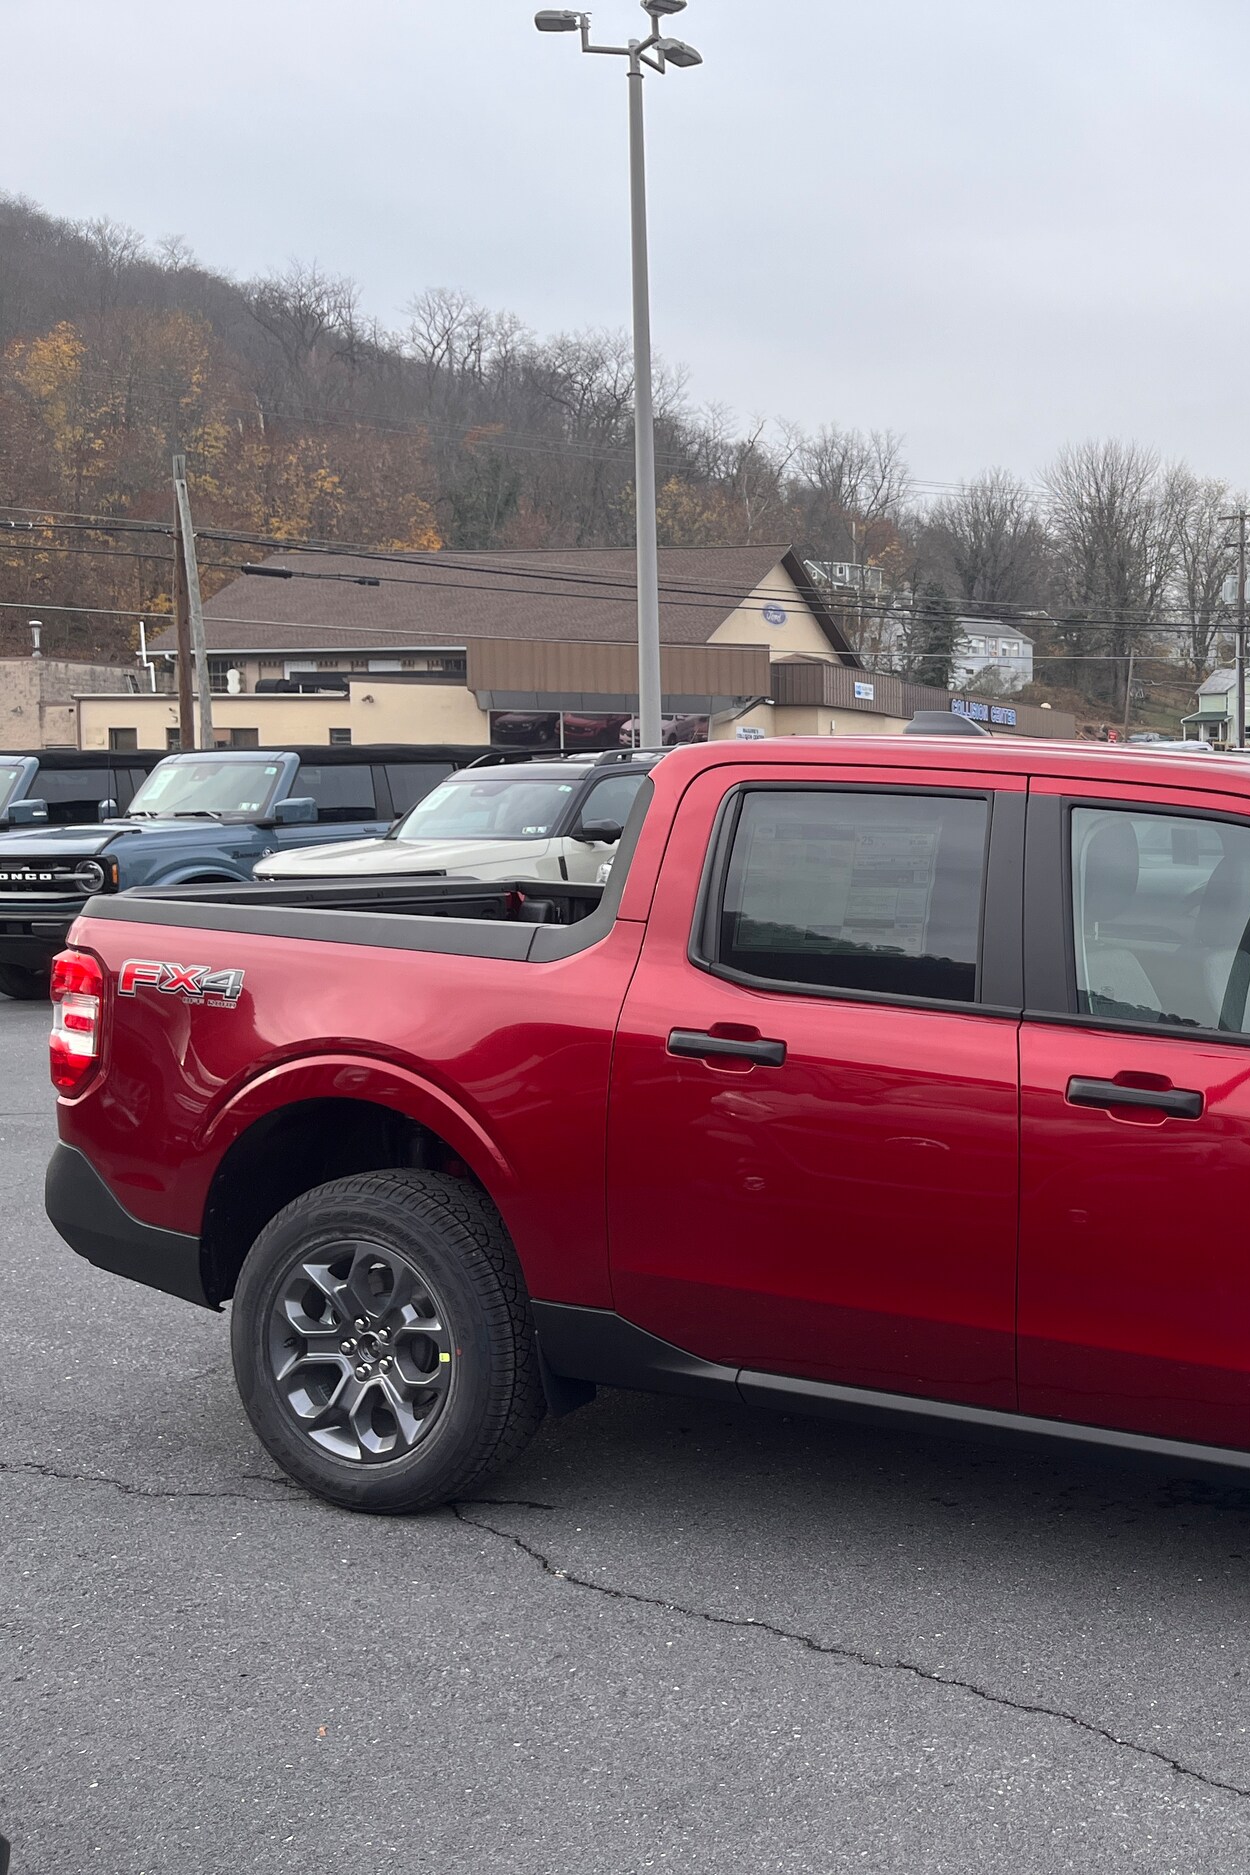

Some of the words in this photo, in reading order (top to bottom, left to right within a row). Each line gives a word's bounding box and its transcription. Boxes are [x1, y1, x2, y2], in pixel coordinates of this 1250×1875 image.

[951, 698, 989, 721] COLLISION
[991, 705, 1016, 726] CENTER
[118, 958, 246, 1001] FX4
